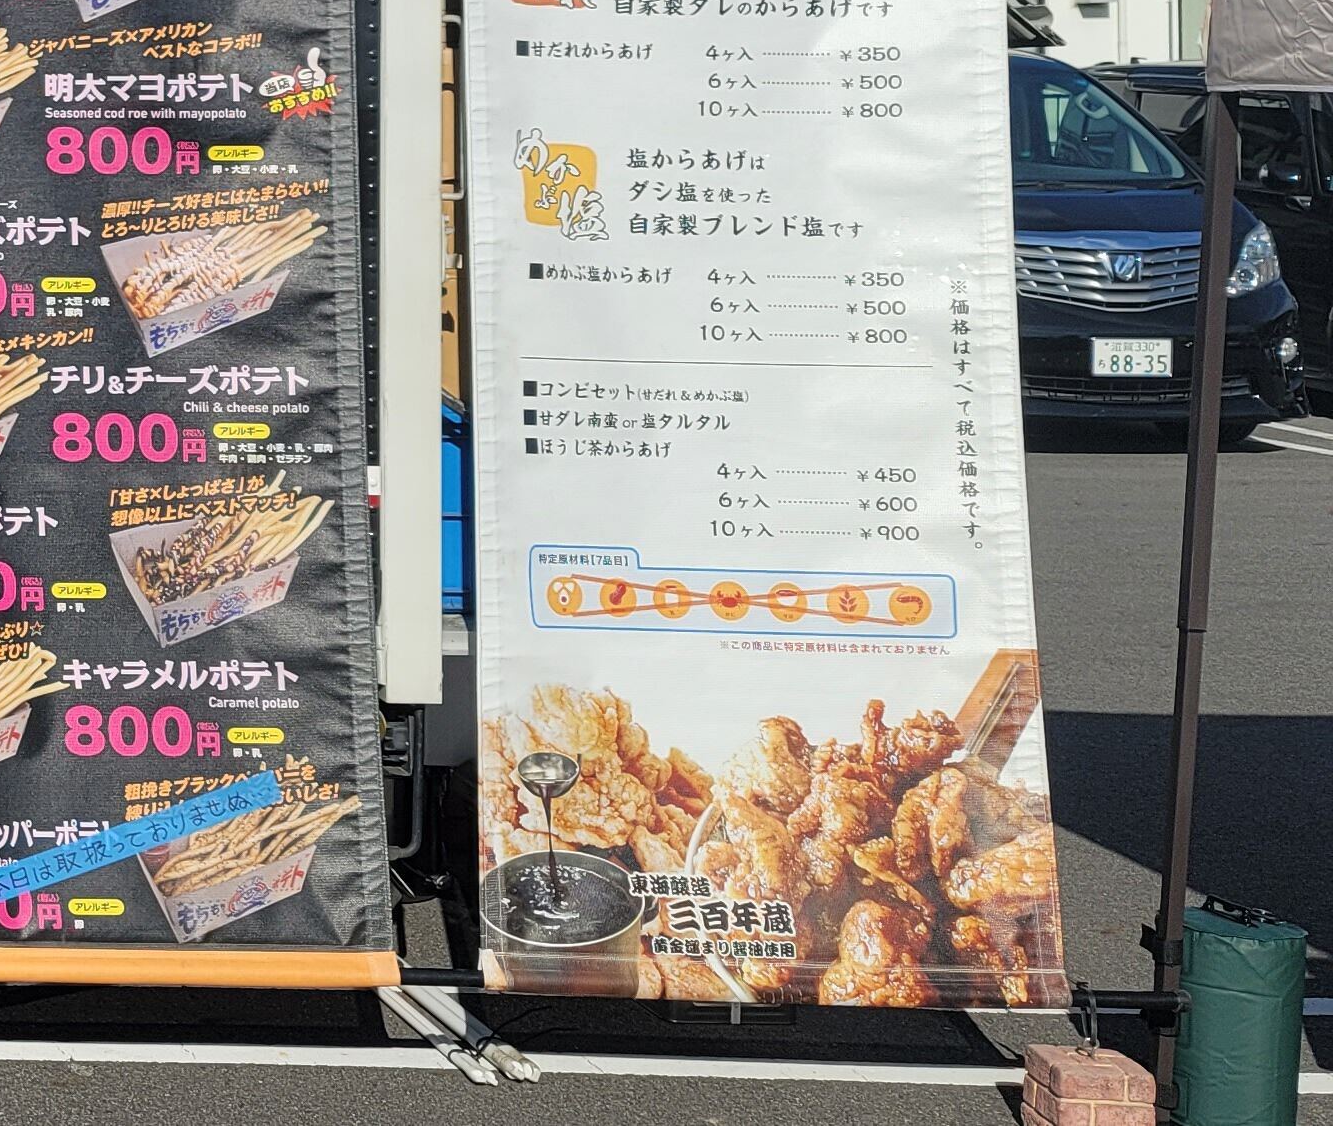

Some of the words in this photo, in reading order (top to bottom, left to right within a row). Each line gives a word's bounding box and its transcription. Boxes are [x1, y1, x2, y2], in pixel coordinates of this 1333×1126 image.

[44, 73, 253, 103] 明太マヨポテト
[45, 106, 101, 120] Seasoned
[104, 107, 129, 119] cod
[132, 109, 147, 119] roe
[150, 107, 176, 119] with
[1110, 355, 1168, 373] 88-35
[50, 366, 310, 396] チリ&チーズポテト
[183, 400, 209, 414] Chili
[212, 401, 222, 414] &
[225, 401, 269, 414] cheese
[272, 401, 310, 416] potato
[62, 660, 299, 692] キャラメルポテト
[208, 696, 259, 709] Caramel
[262, 696, 299, 711] potato
